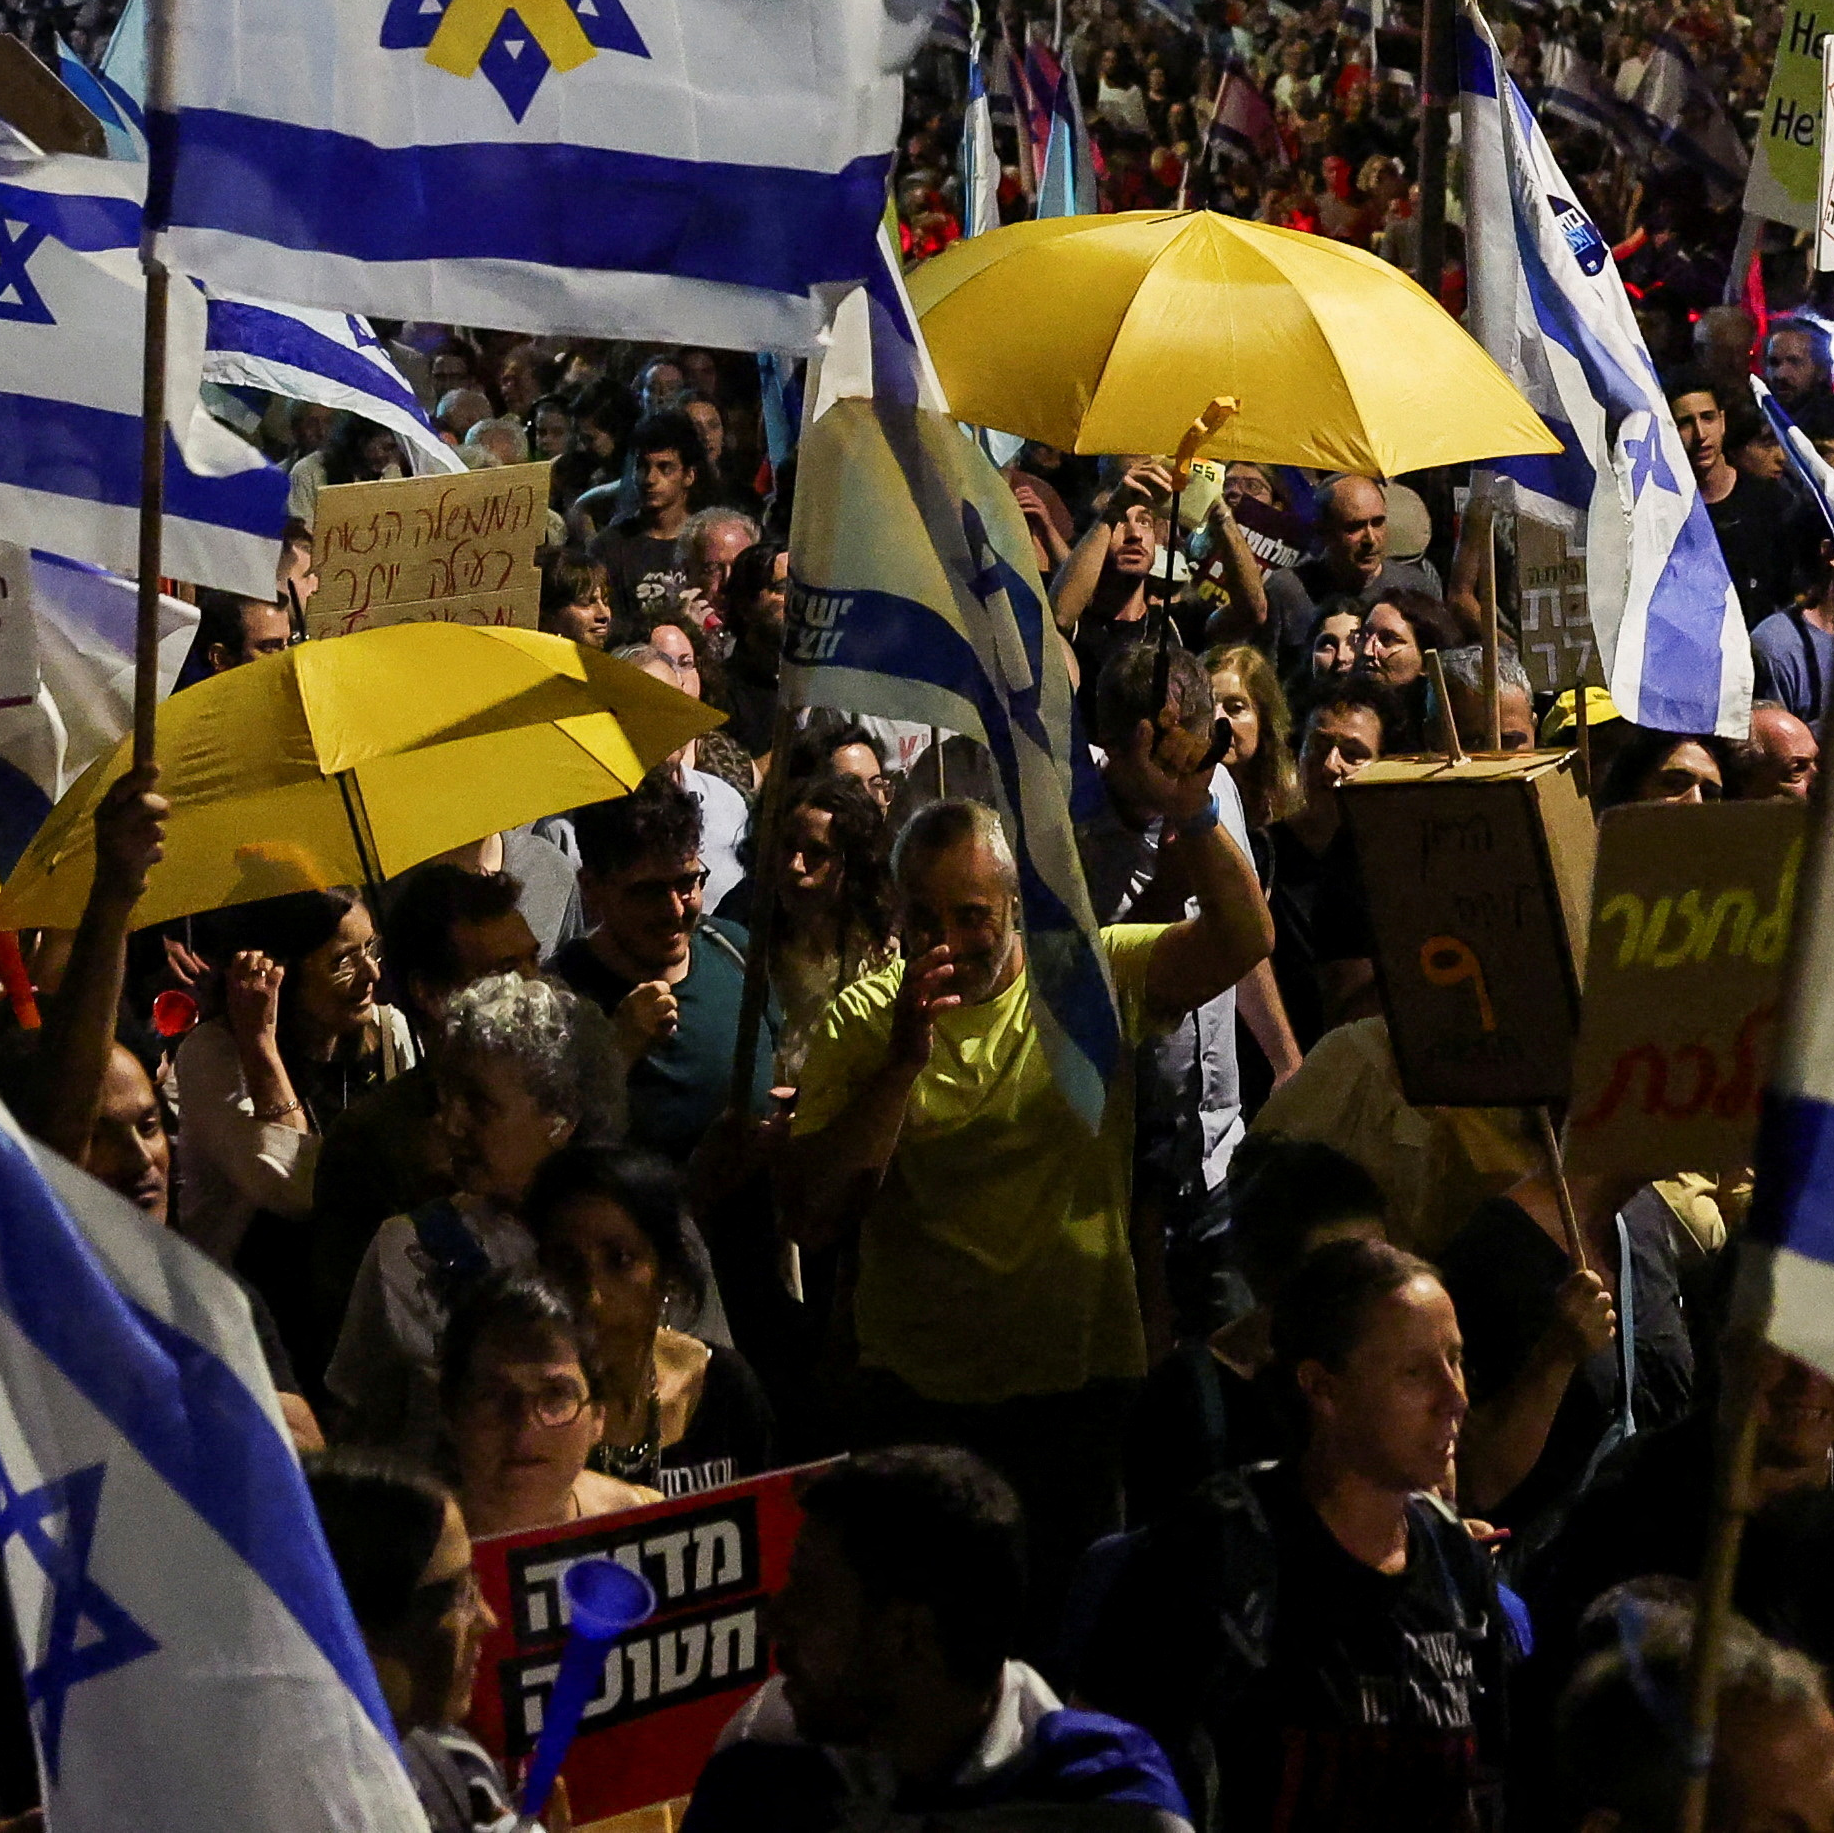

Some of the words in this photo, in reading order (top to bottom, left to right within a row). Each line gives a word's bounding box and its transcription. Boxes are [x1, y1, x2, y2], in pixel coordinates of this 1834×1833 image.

[414, 486, 534, 549] הממשלה
[1570, 1002, 1775, 1130] לכת
[523, 1519, 744, 1635] מדיה
